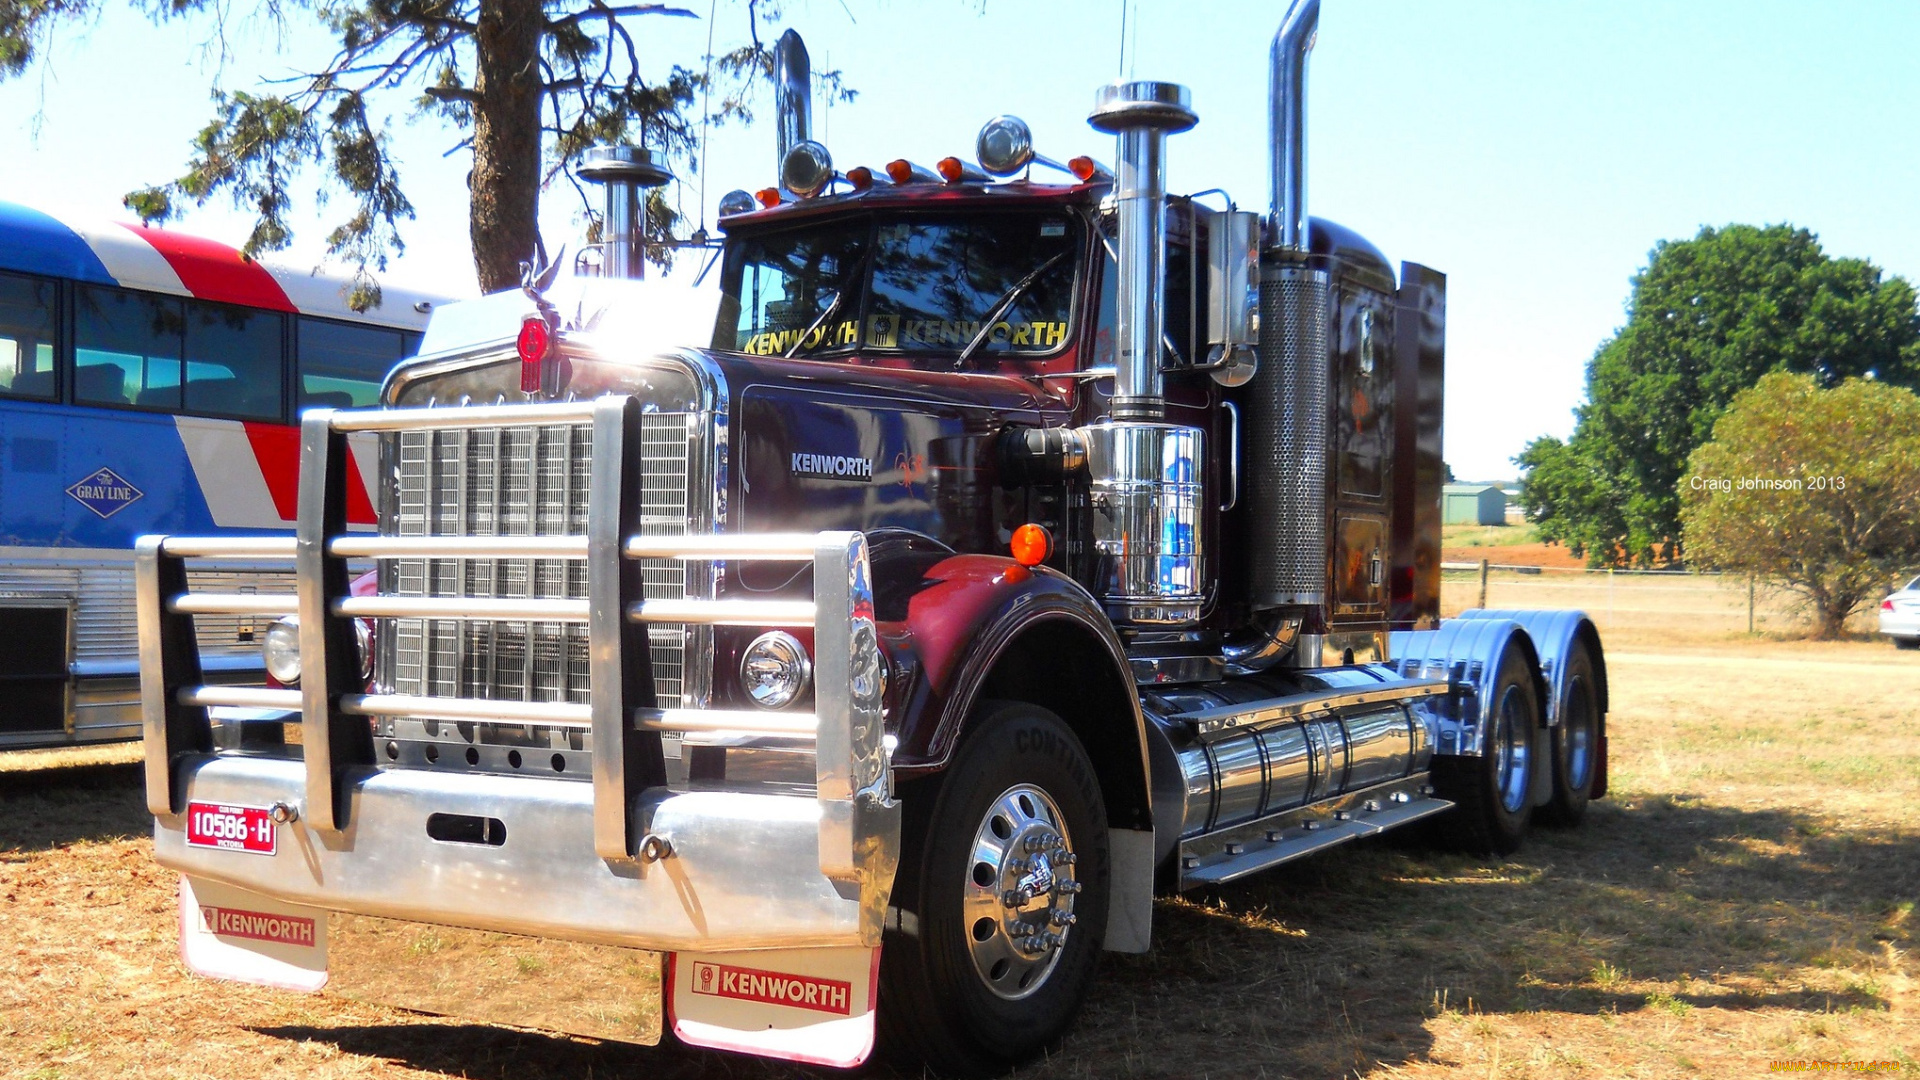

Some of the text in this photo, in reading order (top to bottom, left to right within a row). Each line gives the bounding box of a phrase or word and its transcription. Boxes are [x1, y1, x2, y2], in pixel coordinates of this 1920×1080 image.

[744, 320, 859, 356] KENWOTH
[791, 452, 873, 478] KENWORTH
[97, 473, 113, 485] The
[77, 485, 131, 500] GRAY LINE
[217, 840, 244, 849] VICTORIA
[220, 912, 313, 942] KENWORTH
[722, 970, 847, 1009] KENWORTH
